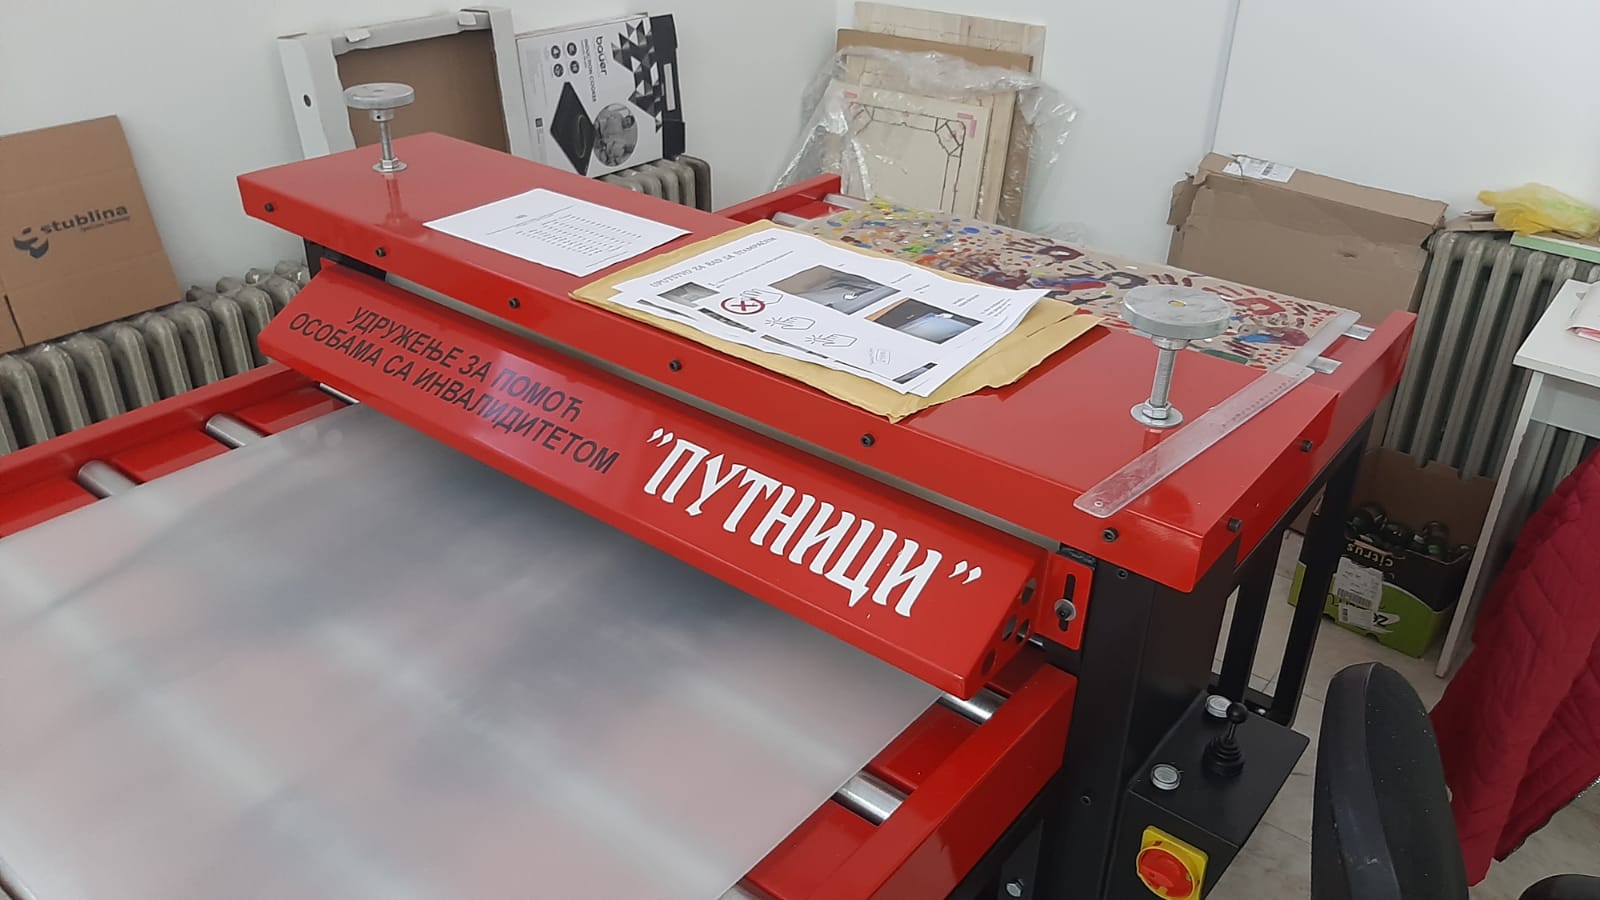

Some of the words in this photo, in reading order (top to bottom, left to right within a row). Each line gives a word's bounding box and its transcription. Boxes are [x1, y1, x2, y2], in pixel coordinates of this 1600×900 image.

[595, 35, 607, 76] bauer
[40, 205, 129, 234] stublina
[346, 306, 463, 369] УДРУЖЕЊЕ
[459, 355, 492, 382] ЗА
[490, 367, 583, 423] ПОМОЋ
[289, 312, 385, 367] ОСОБАМА
[382, 355, 415, 381] СА
[411, 369, 620, 475] ИНВАЛИДИТЕТОМ
[1346, 543, 1394, 568] citrus
